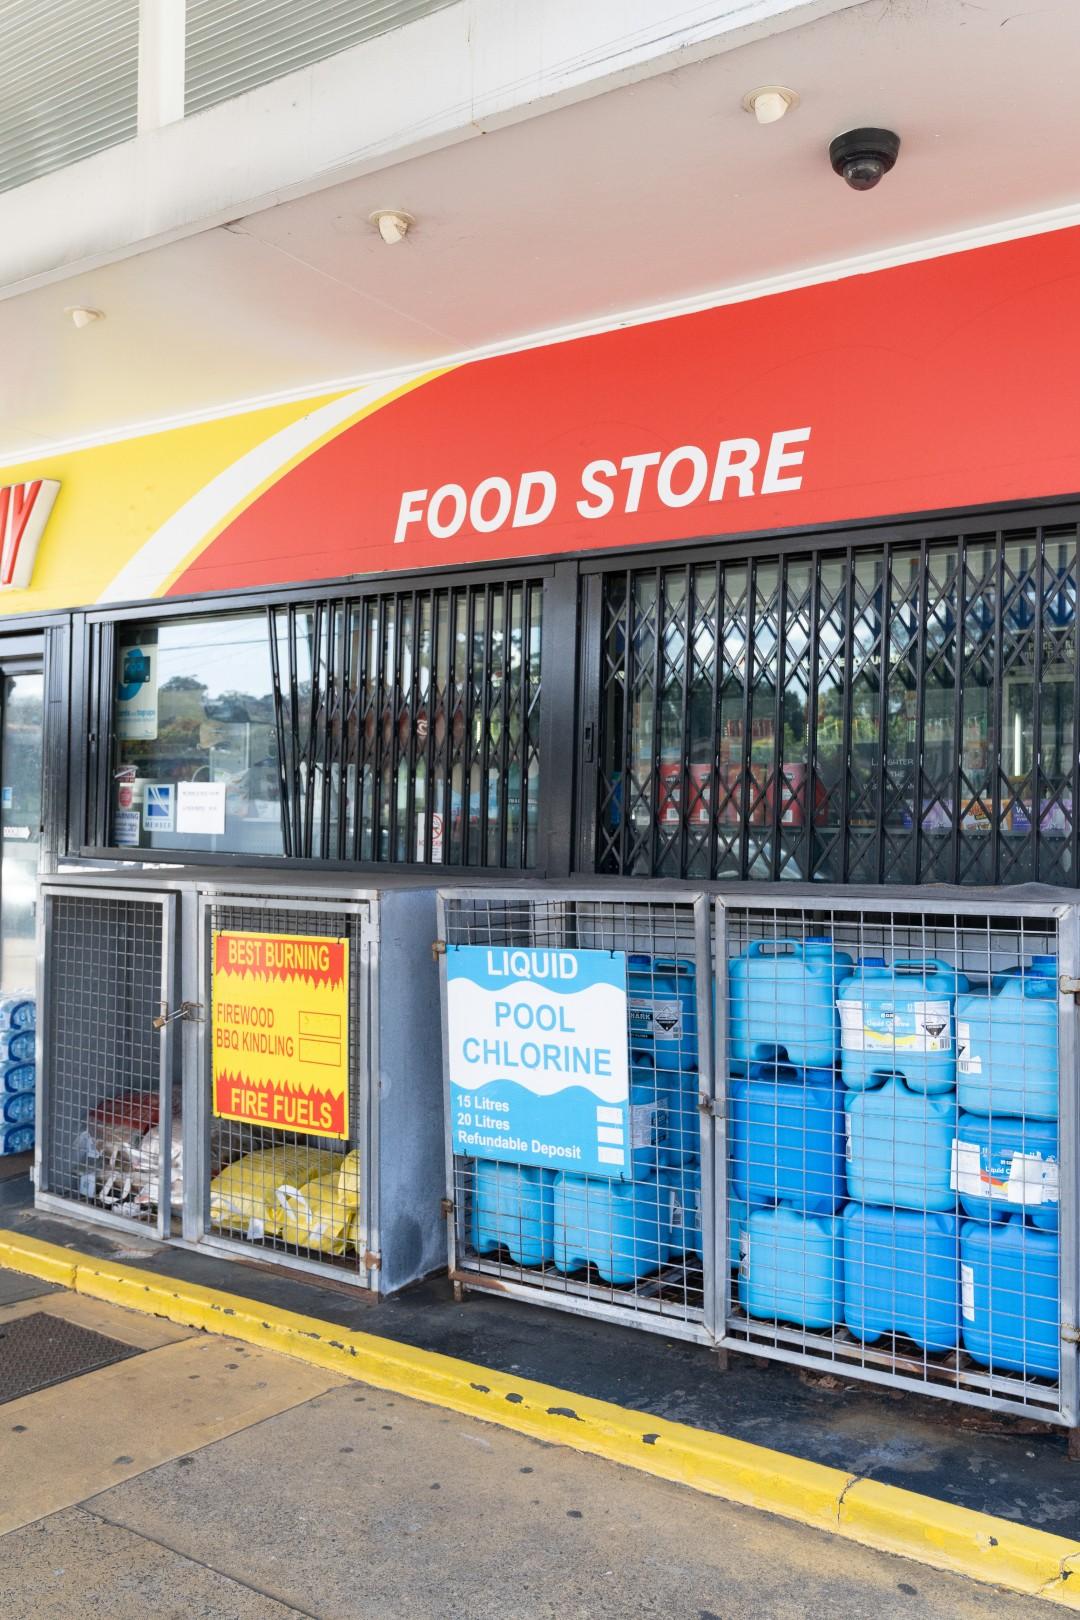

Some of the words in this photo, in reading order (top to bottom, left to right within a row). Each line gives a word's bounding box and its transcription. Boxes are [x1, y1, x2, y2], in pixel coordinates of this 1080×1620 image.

[394, 470, 557, 544] FOOD
[576, 427, 811, 519] STORE
[228, 940, 262, 966] BEST
[265, 943, 330, 971] BURNING
[487, 950, 579, 979] LIQUID
[217, 1003, 274, 1028] FIREWOOD
[495, 1001, 576, 1032] POOL
[216, 1028, 239, 1050] BBQ
[242, 1032, 294, 1057] KINDLING
[462, 1037, 612, 1077] CHLORINE
[231, 1088, 269, 1118] FIRE
[273, 1095, 333, 1129] FUELS
[456, 1095, 471, 1108] 15
[474, 1097, 510, 1112] Litres
[457, 1112, 472, 1126] 20
[475, 1114, 510, 1130] Litres
[458, 1130, 528, 1152] Refundable
[531, 1140, 581, 1160] Deposit
[985, 1166, 1004, 1174] Lquid
